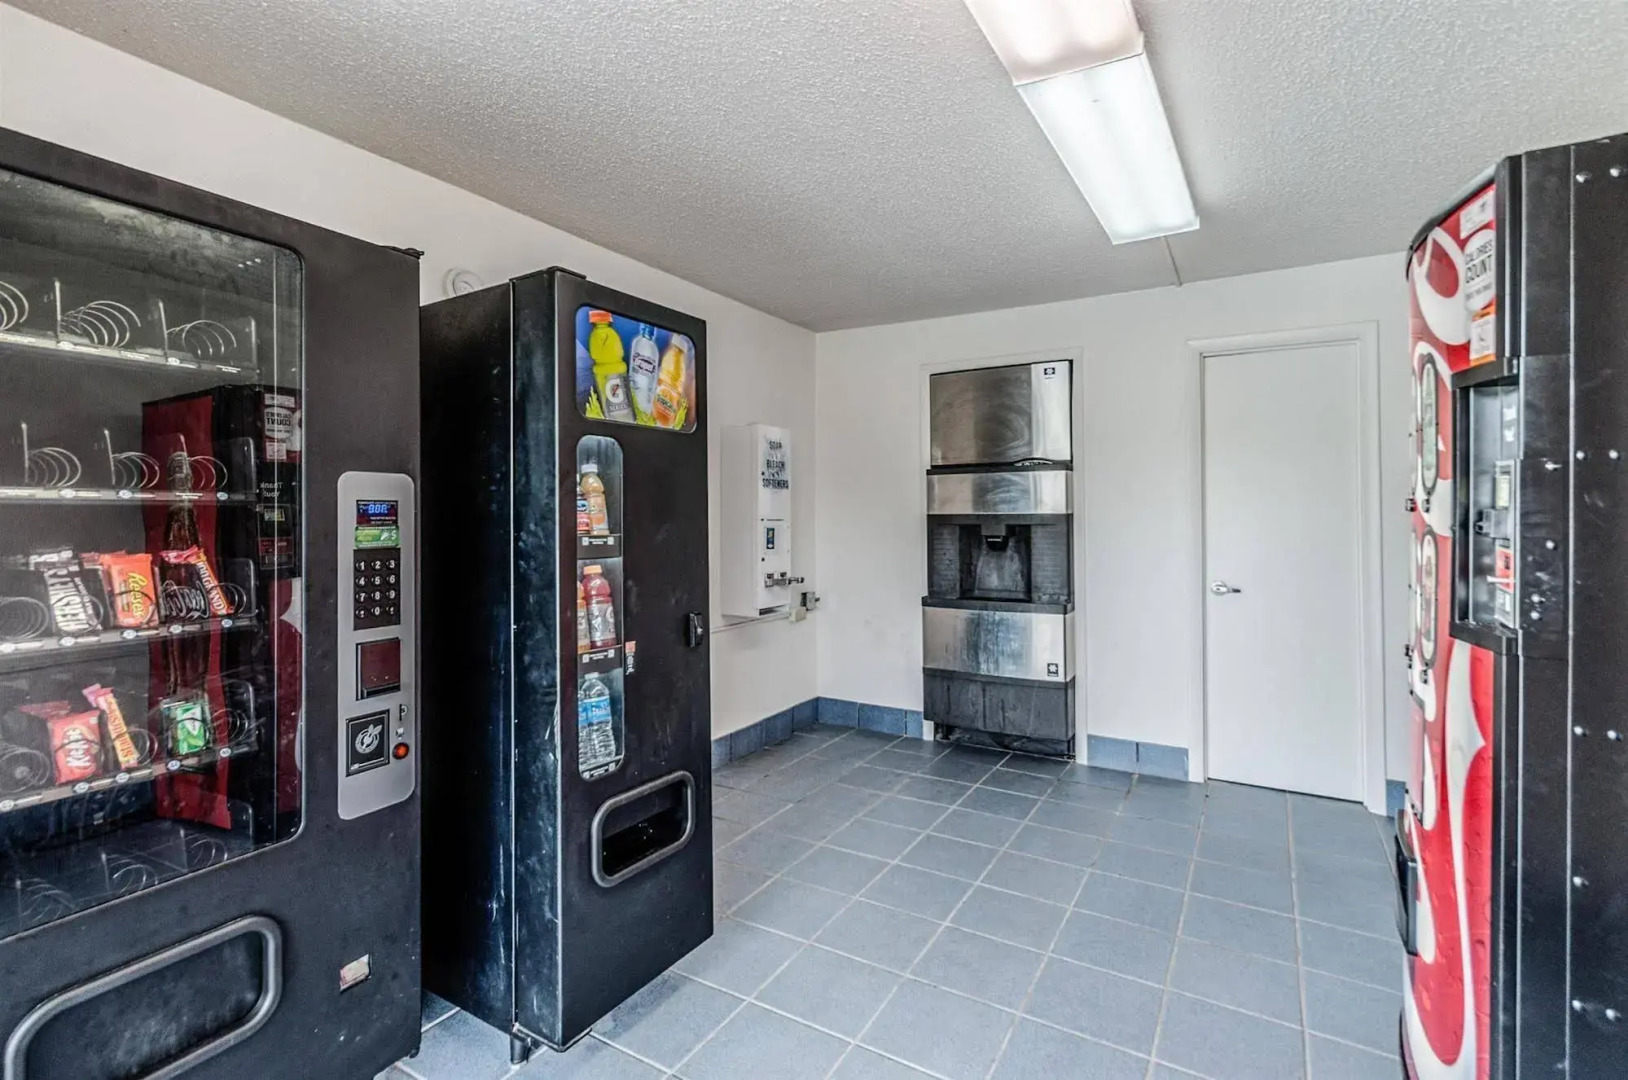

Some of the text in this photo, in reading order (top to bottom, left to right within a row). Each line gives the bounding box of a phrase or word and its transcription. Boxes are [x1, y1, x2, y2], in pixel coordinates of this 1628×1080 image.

[1466, 254, 1494, 284] COUNT
[767, 459, 785, 469] BLEACH
[762, 478, 789, 490] SOFTENERS
